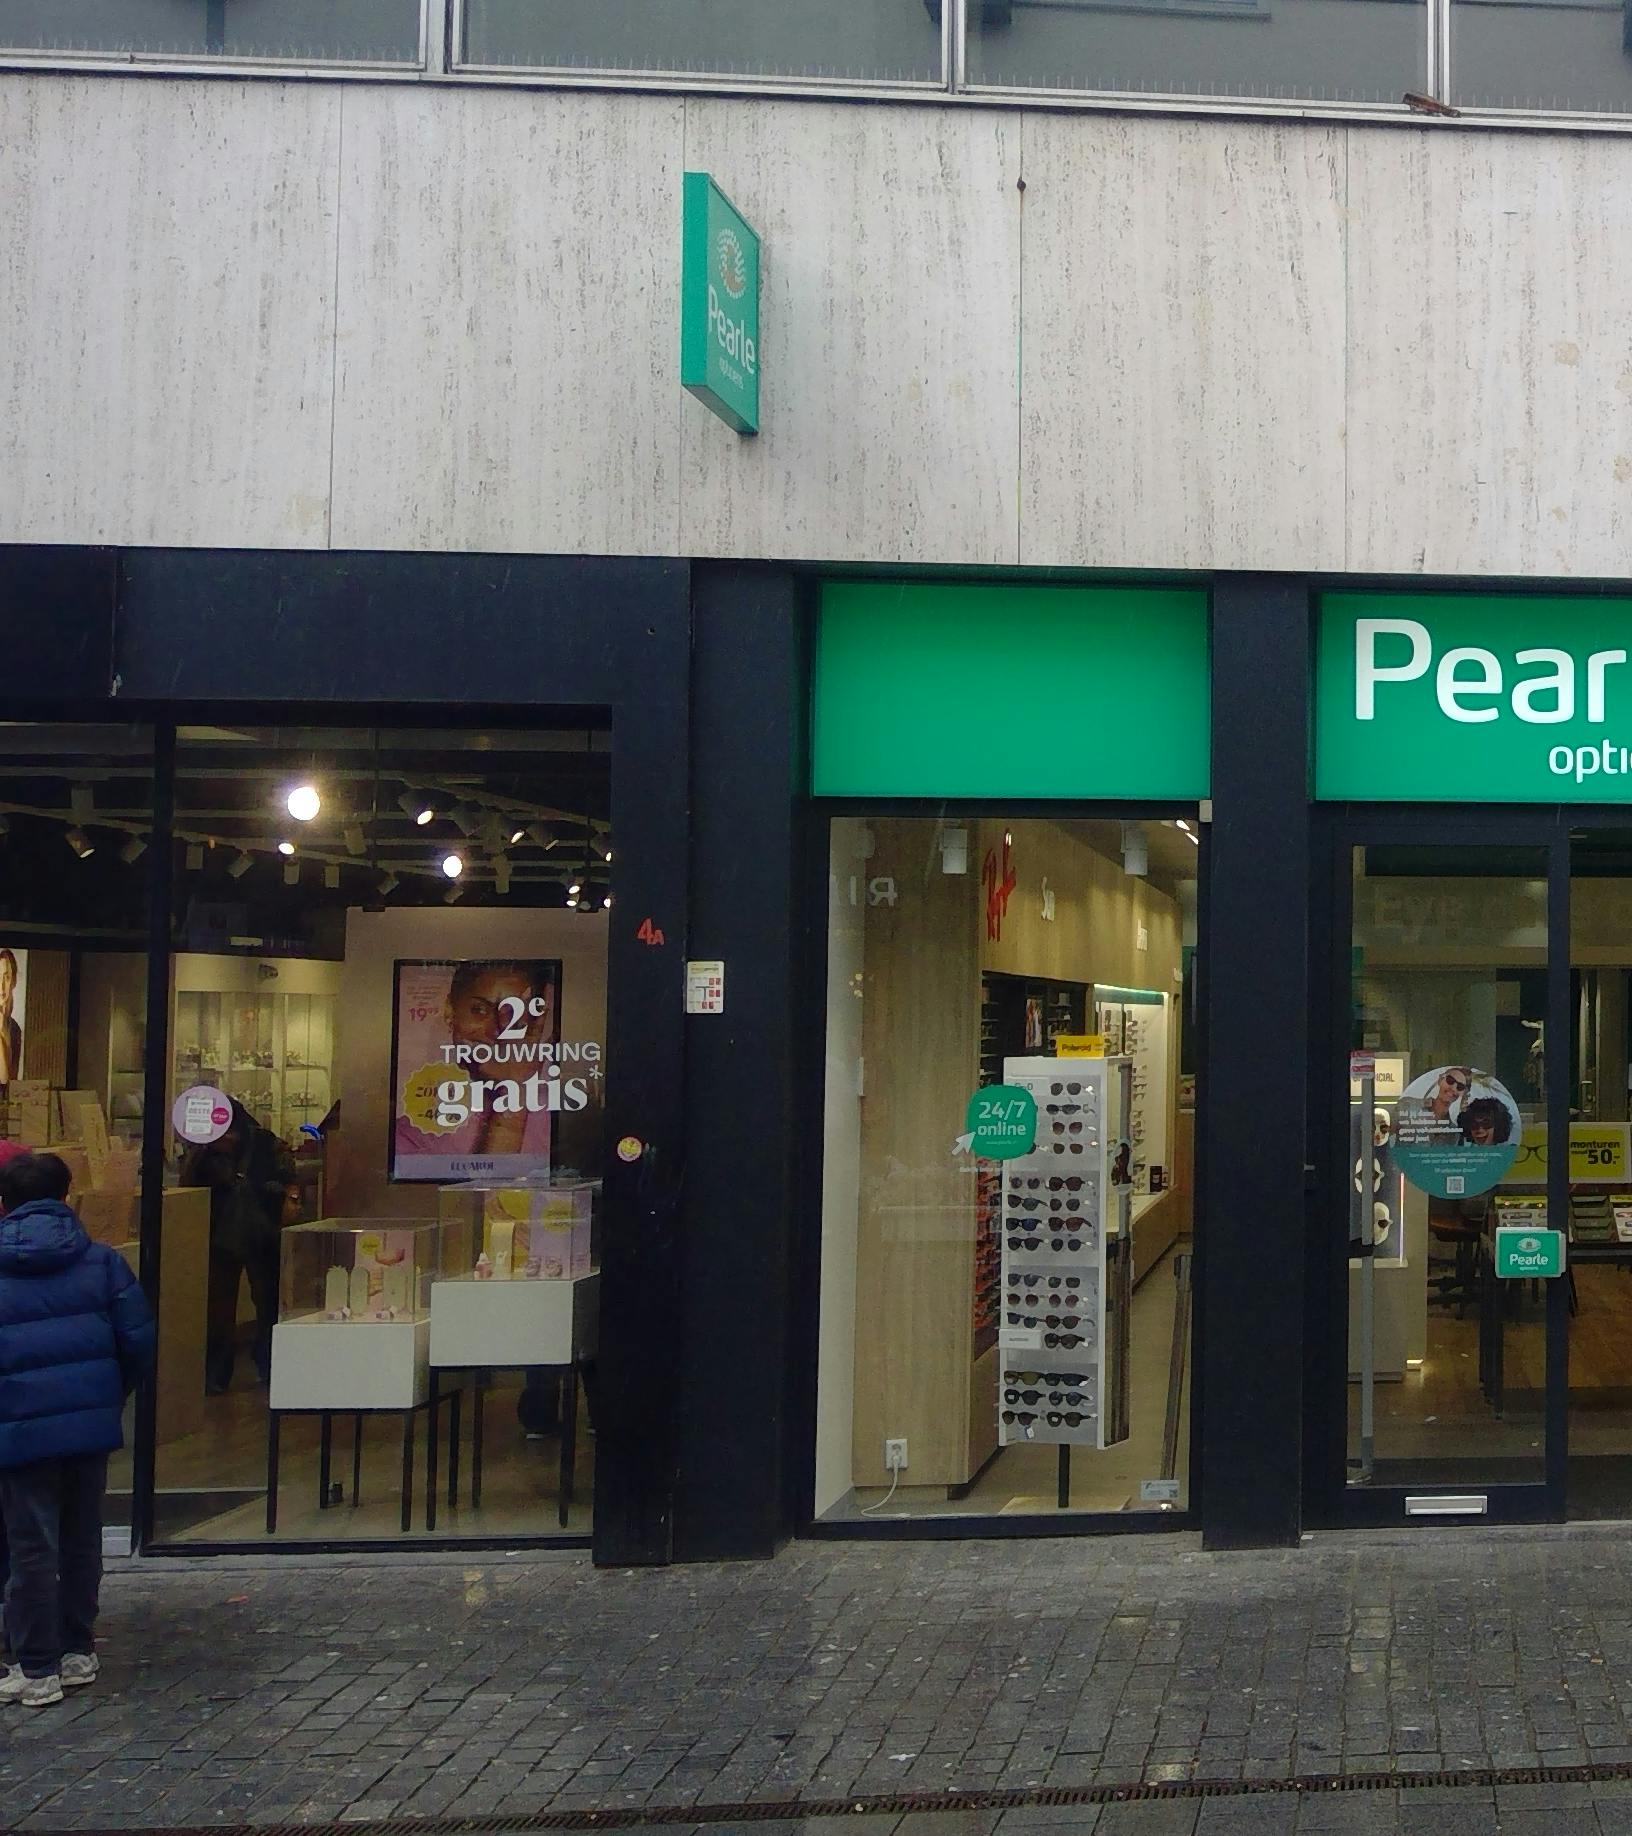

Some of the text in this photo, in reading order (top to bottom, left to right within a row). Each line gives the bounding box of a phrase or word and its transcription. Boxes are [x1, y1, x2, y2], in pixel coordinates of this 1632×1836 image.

[707, 284, 756, 375] Pearle
[497, 996, 546, 1041] 2e
[440, 1042, 602, 1065] TROUWRING
[978, 1099, 1027, 1120] 24/7
[977, 1121, 1027, 1136] online
[1509, 1252, 1549, 1266] Pearle
